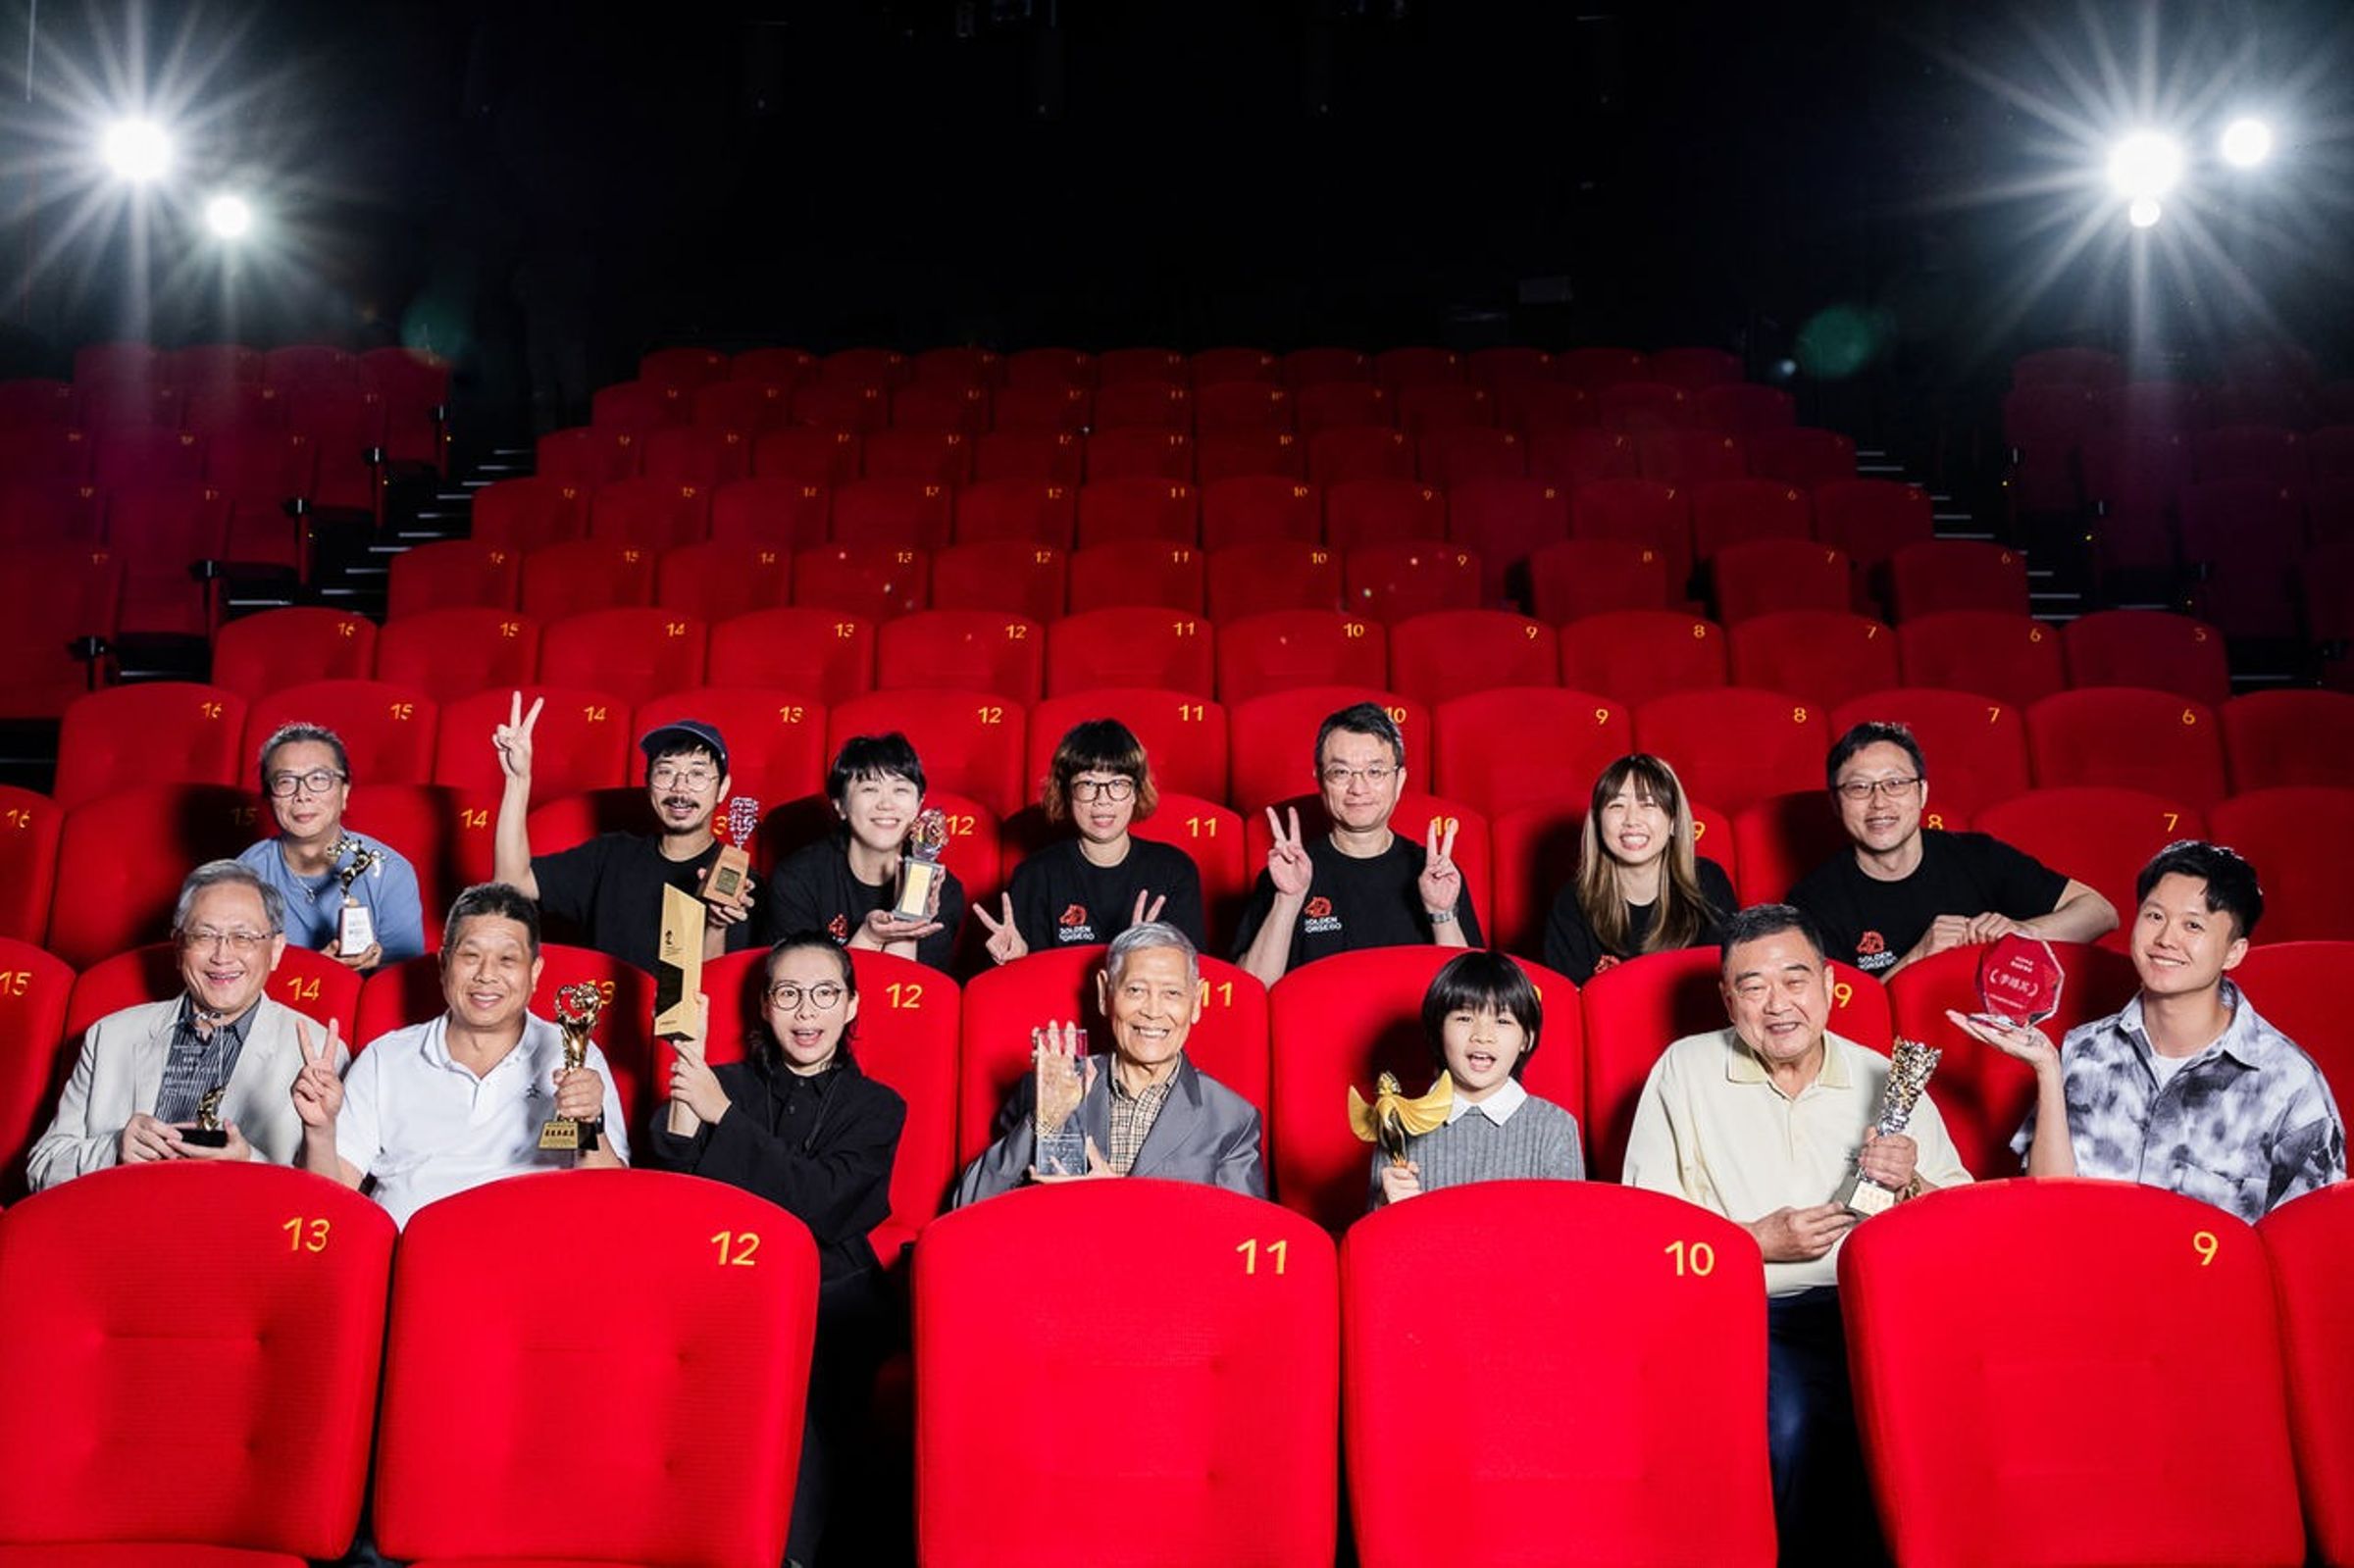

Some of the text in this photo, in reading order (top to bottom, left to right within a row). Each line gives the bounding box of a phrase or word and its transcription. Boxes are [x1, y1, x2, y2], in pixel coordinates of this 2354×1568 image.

[1170, 486, 1186, 498] 11
[1294, 486, 1308, 497] 10
[1422, 489, 1432, 500] 9
[625, 550, 640, 562] 15
[761, 552, 776, 564] 14
[896, 551, 913, 564] 13
[1035, 551, 1051, 564] 12
[1171, 550, 1190, 563] 11
[1310, 551, 1328, 565] 10
[1458, 554, 1468, 567] 9
[337, 622, 357, 638] 16
[500, 622, 520, 638] 15
[665, 622, 686, 637] 14
[835, 622, 855, 639] 13
[1004, 623, 1027, 639] 12
[1175, 621, 1196, 637] 11
[1342, 622, 1366, 638] 10
[1525, 625, 1539, 640] 9
[1693, 624, 1707, 639] 8
[1868, 626, 1878, 640] 7
[2028, 628, 2042, 643] 6
[2194, 626, 2208, 642] 5
[200, 701, 223, 720] 16
[390, 702, 414, 721] 15
[585, 705, 607, 724] 14
[779, 705, 804, 724] 13
[978, 705, 1004, 724] 12
[1179, 704, 1204, 723] 11
[1384, 706, 1407, 724] 10
[1594, 707, 1612, 726] 9
[1792, 706, 1809, 724] 8
[1988, 706, 2001, 724] 7
[2181, 707, 2197, 726] 6
[6, 808, 31, 829] 16
[461, 807, 488, 830] 14
[946, 814, 976, 836] 12
[1186, 815, 1218, 838] 11
[1927, 813, 1944, 832] 8
[2162, 812, 2179, 833] 7
[1693, 820, 1707, 841] 9
[0, 970, 32, 996] 15
[287, 976, 322, 1001] 14
[885, 983, 925, 1010] 12
[1202, 981, 1234, 1008] 11
[1832, 983, 1854, 1010] 9
[281, 1215, 334, 1254] 13
[709, 1230, 762, 1268] 12
[1234, 1238, 1289, 1277] 11
[2191, 1230, 2220, 1268] 9
[1663, 1239, 1715, 1278] 10
